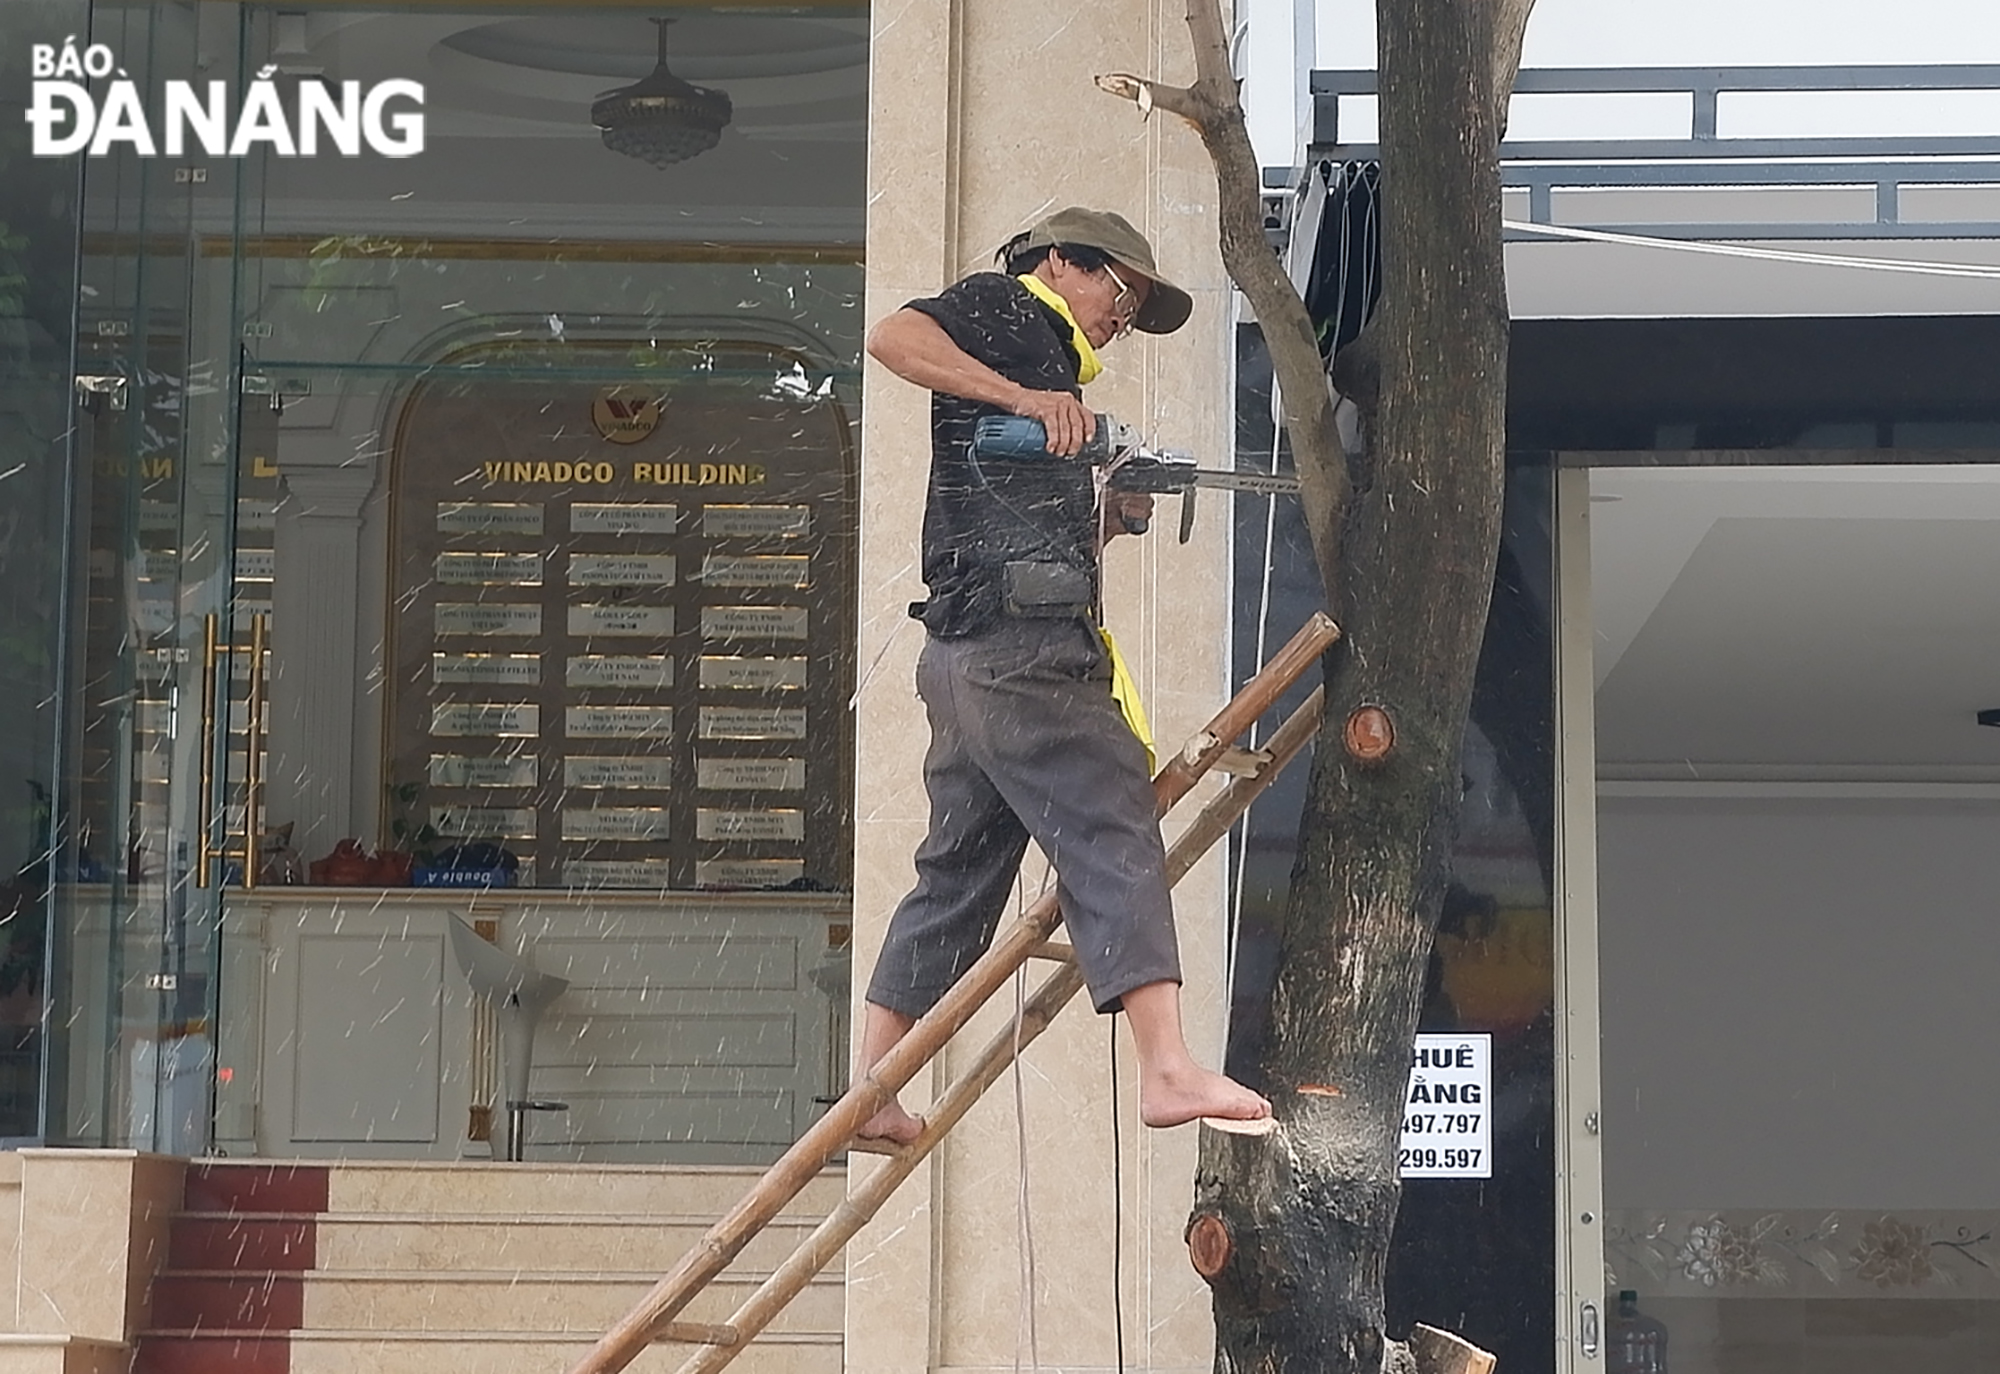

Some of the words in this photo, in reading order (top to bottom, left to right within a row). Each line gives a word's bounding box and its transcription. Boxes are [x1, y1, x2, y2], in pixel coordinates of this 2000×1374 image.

[485, 461, 614, 483] VINADCO
[428, 872, 438, 883] A
[442, 872, 491, 883] Double
[1400, 1149, 1482, 1168] 299.597
